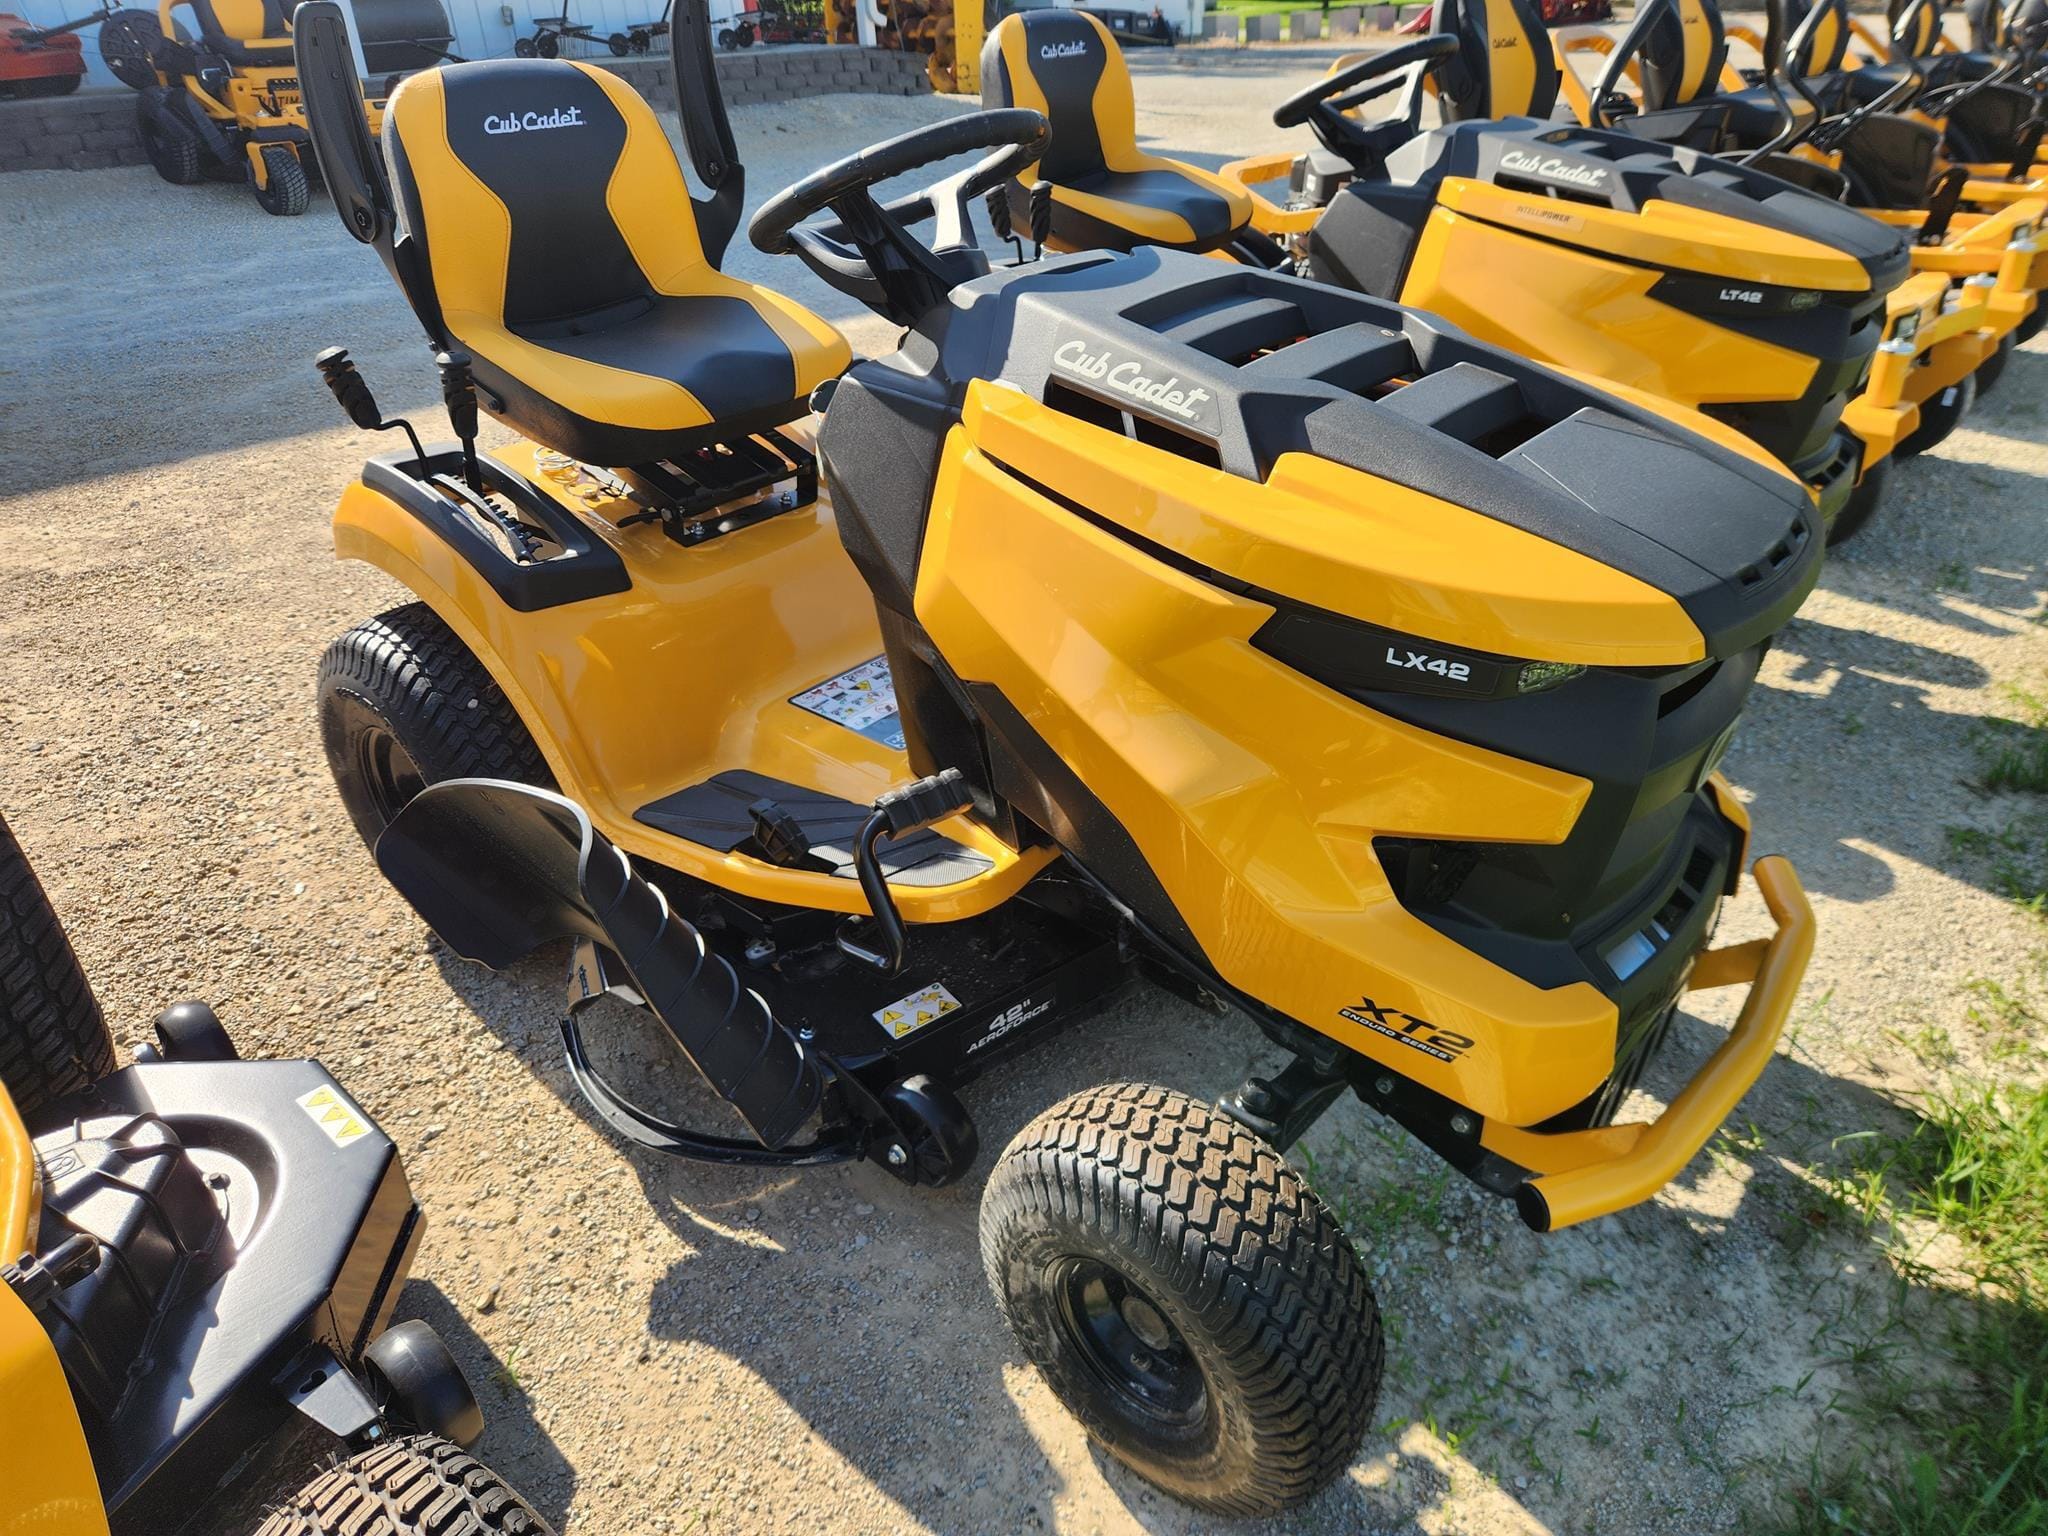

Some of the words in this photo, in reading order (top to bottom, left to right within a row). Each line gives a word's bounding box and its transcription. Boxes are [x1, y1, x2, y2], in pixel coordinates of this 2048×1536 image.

[484, 112, 521, 134] Cub
[522, 106, 583, 130] Cadet
[1501, 150, 1541, 172] Cub
[1538, 159, 1608, 187] Cadet
[1719, 288, 1763, 303] LT42
[1053, 340, 1111, 379] Cub
[1107, 361, 1210, 418] Cadet
[1386, 647, 1470, 682] LX42
[966, 1000, 1050, 1054] AEROFORCE
[1340, 1009, 1397, 1037] ENDURO
[1400, 1036, 1451, 1060] SERIES
[1345, 996, 1475, 1055] XT2
